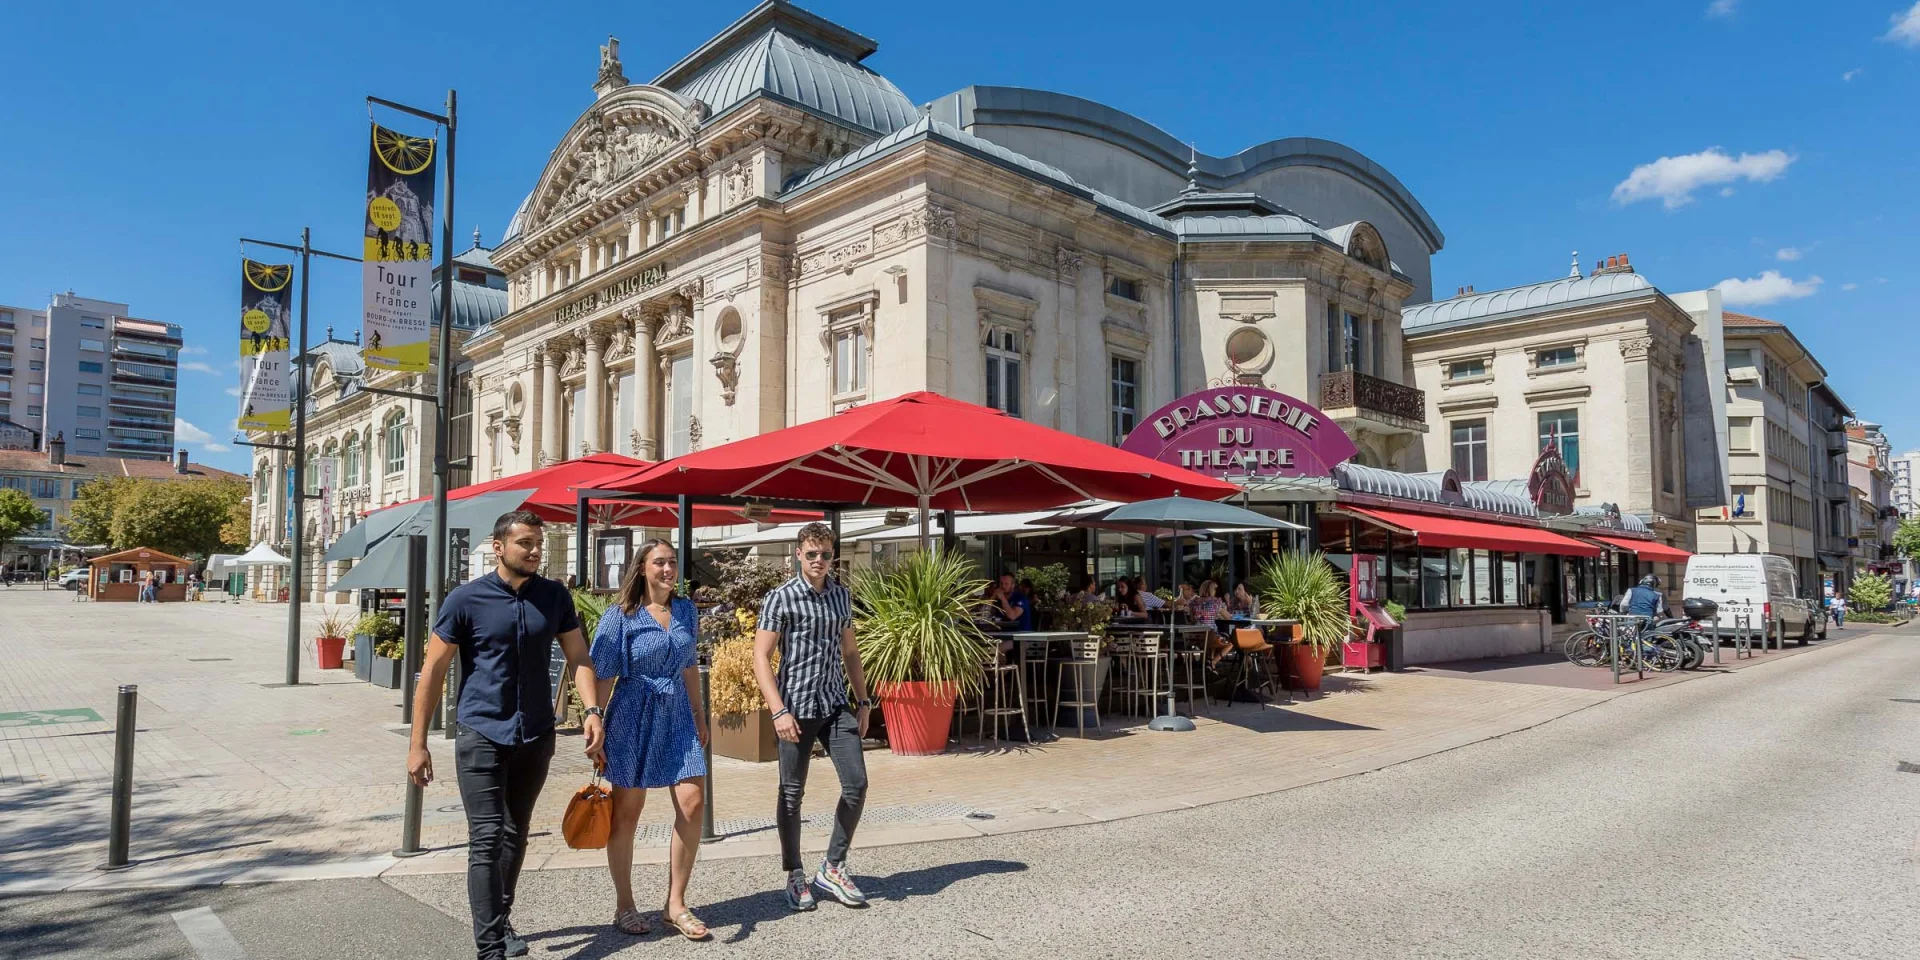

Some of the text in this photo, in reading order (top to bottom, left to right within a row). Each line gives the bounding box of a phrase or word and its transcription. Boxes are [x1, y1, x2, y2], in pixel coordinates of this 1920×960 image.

[377, 265, 417, 288] Tour
[375, 291, 417, 309] France
[390, 286, 401, 296] de
[554, 263, 666, 323] THEATRE MUNICIPAL
[251, 357, 280, 371] Tour
[1152, 394, 1320, 439] BRASSERIE
[1218, 427, 1253, 445] DU
[1178, 448, 1294, 466] THEATRE
[322, 465, 331, 526] CINEMA
